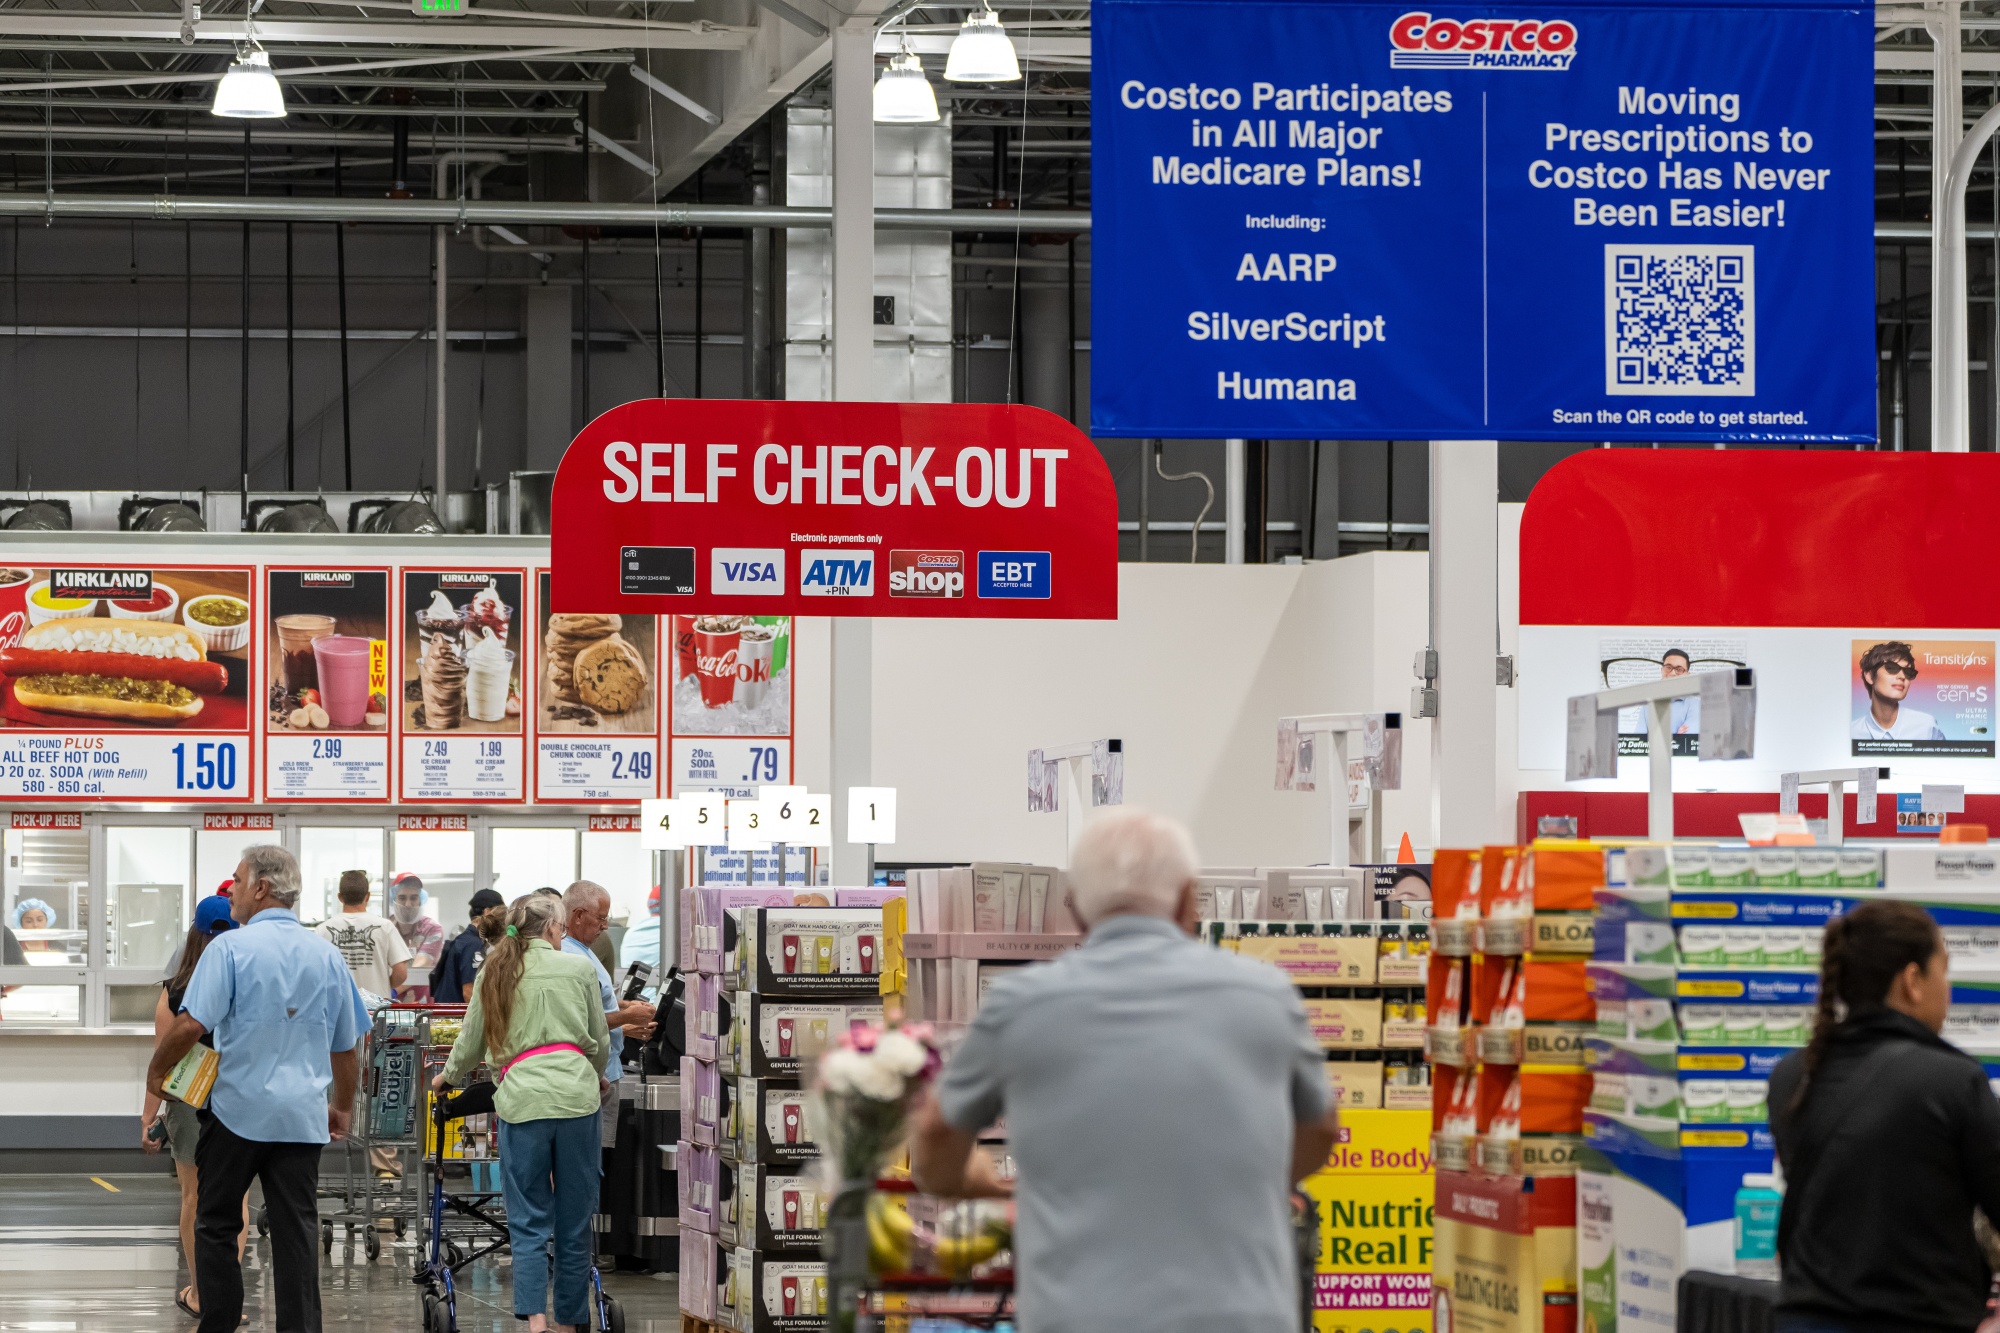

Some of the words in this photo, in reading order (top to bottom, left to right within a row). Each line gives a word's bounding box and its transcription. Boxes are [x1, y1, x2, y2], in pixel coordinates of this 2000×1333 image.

[1389, 12, 1577, 52] COSTCO
[1472, 54, 1571, 68] PHARMACY
[1121, 80, 1241, 110] Costco
[1252, 82, 1453, 119] Participates
[1618, 86, 1740, 122] Moving
[1192, 119, 1222, 147] in
[1232, 119, 1276, 148] All
[1289, 120, 1383, 156] Major
[1545, 123, 1769, 159] Prescriptions
[1779, 126, 1813, 153] to
[1152, 156, 1306, 185] Medicare
[1317, 158, 1421, 187] Plans!
[1528, 160, 1648, 189] Costco
[1659, 161, 1722, 189] Has
[1734, 162, 1830, 190] Never
[1574, 198, 1658, 226] Been
[1670, 199, 1785, 227] Easier!
[1246, 214, 1326, 232] Including:
[1236, 253, 1337, 281] AARP
[1187, 311, 1386, 348] SilverScript
[1217, 371, 1356, 400] Humana
[1553, 409, 1592, 423] Scan
[1597, 410, 1622, 423] the
[1626, 410, 1651, 424] QR
[1655, 410, 1694, 424] code
[1698, 411, 1715, 424] to
[1719, 411, 1744, 427] get
[1748, 411, 1808, 425] started.
[603, 441, 738, 503] SELF
[753, 445, 1068, 508] CHECK-OUT
[791, 533, 827, 542] Electronic
[829, 534, 865, 544] payments
[867, 534, 882, 544] only
[624, 549, 636, 557] citi
[917, 554, 959, 564] COSTCO
[304, 573, 351, 582] KIRKLAND
[442, 574, 488, 583] KIRKLAND
[719, 562, 777, 582] VISA
[802, 559, 872, 586] ATM
[992, 562, 1036, 581] EBT
[56, 572, 148, 588] KIRKLAND
[890, 566, 963, 597] shop
[55, 586, 148, 600] Signature
[825, 586, 850, 595] +PIN
[371, 645, 385, 688] NEW
[1924, 652, 1987, 669] Transitions
[29, 739, 62, 749] POUND
[64, 738, 105, 749] PLUS
[313, 739, 342, 759] 2.99
[425, 741, 447, 757] 2.49
[480, 741, 502, 757] 1.99
[3, 751, 25, 763] ALL
[30, 751, 60, 763] BEEF
[64, 751, 88, 763] HOT
[93, 752, 120, 764] DOG
[691, 749, 714, 758] 20oz.
[172, 743, 236, 790] 1.50
[612, 751, 651, 779] 2.49
[691, 759, 715, 768] SODA
[742, 747, 778, 782] .79
[9, 766, 24, 778] 20
[28, 768, 45, 778] oz.
[50, 766, 84, 778] SODA
[88, 768, 115, 780] (With
[117, 768, 148, 780] Refill)
[688, 770, 702, 779] WITH
[703, 770, 718, 779] REFILL
[22, 781, 44, 793] 580
[57, 781, 80, 793] 850
[84, 781, 105, 793] cal.
[737, 789, 753, 797] cal.
[698, 808, 708, 824] 5
[780, 802, 792, 819] 6
[809, 808, 820, 825] 2
[870, 803, 876, 821] 1
[13, 814, 52, 827] PICK-UP
[55, 814, 80, 827] HERE
[205, 815, 244, 828] PICK-UP
[247, 815, 272, 828] HERE
[400, 817, 438, 829] PICK-UP
[441, 817, 465, 829] HERE
[590, 817, 629, 829] PICK-UP
[659, 815, 670, 831] 4
[748, 813, 758, 828] 3
[720, 858, 744, 868] calorie
[986, 942, 1018, 950] BEAUTY
[1326, 1148, 1362, 1168] ole
[1371, 1148, 1432, 1173] Body
[1332, 1235, 1406, 1265] Real
[1349, 1293, 1384, 1307] AND
[1387, 1293, 1432, 1307] BEAU
